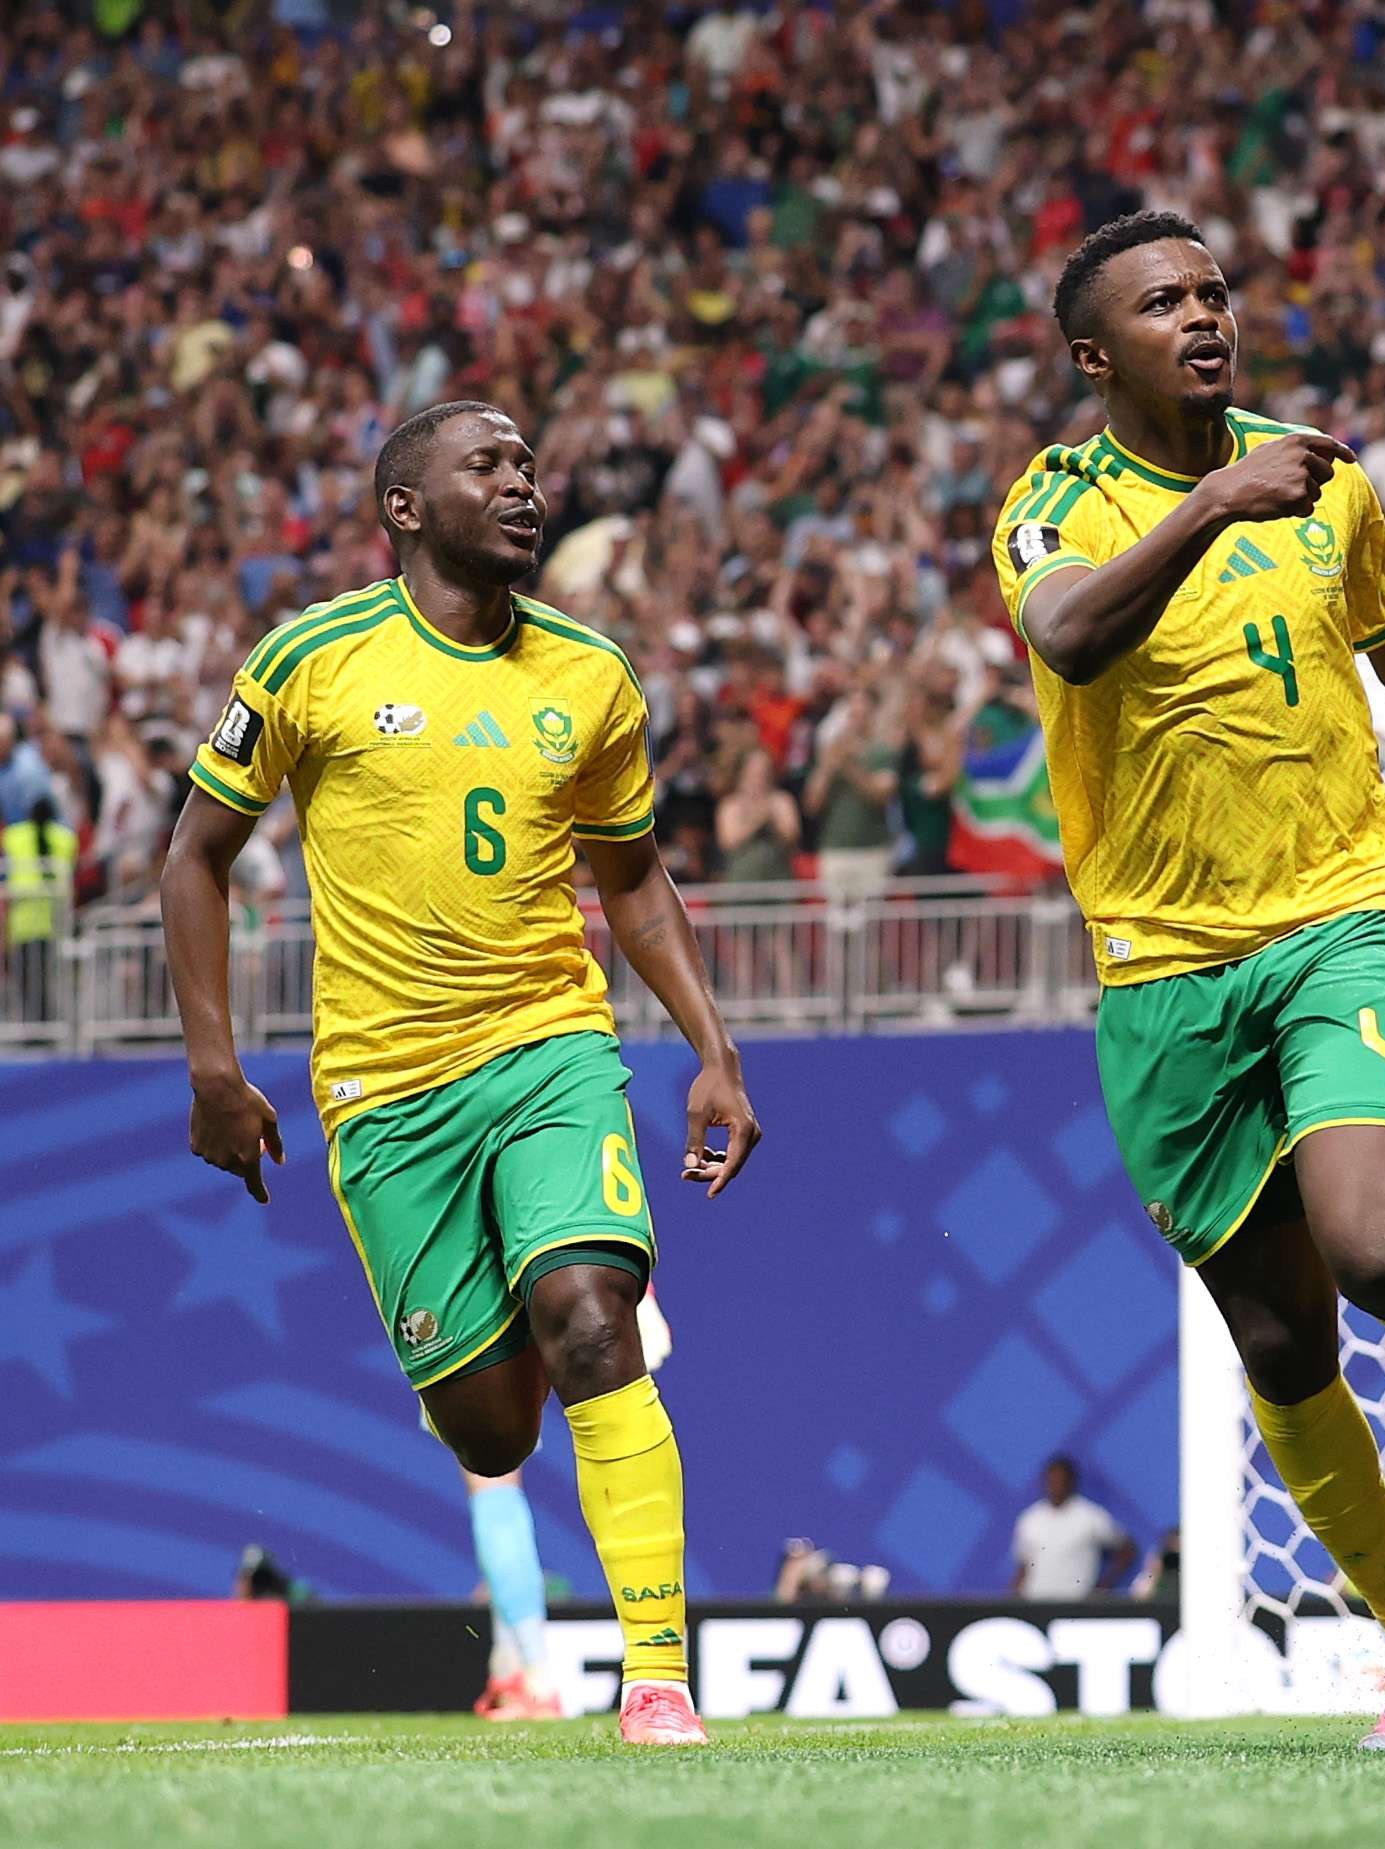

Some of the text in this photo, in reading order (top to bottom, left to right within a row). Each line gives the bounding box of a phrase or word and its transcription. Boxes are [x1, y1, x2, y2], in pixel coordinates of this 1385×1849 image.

[1243, 614, 1299, 707] 4
[464, 786, 506, 876] 6
[601, 1133, 643, 1218] 6
[621, 1581, 683, 1603] SAFA
[545, 1617, 900, 1718] FFA
